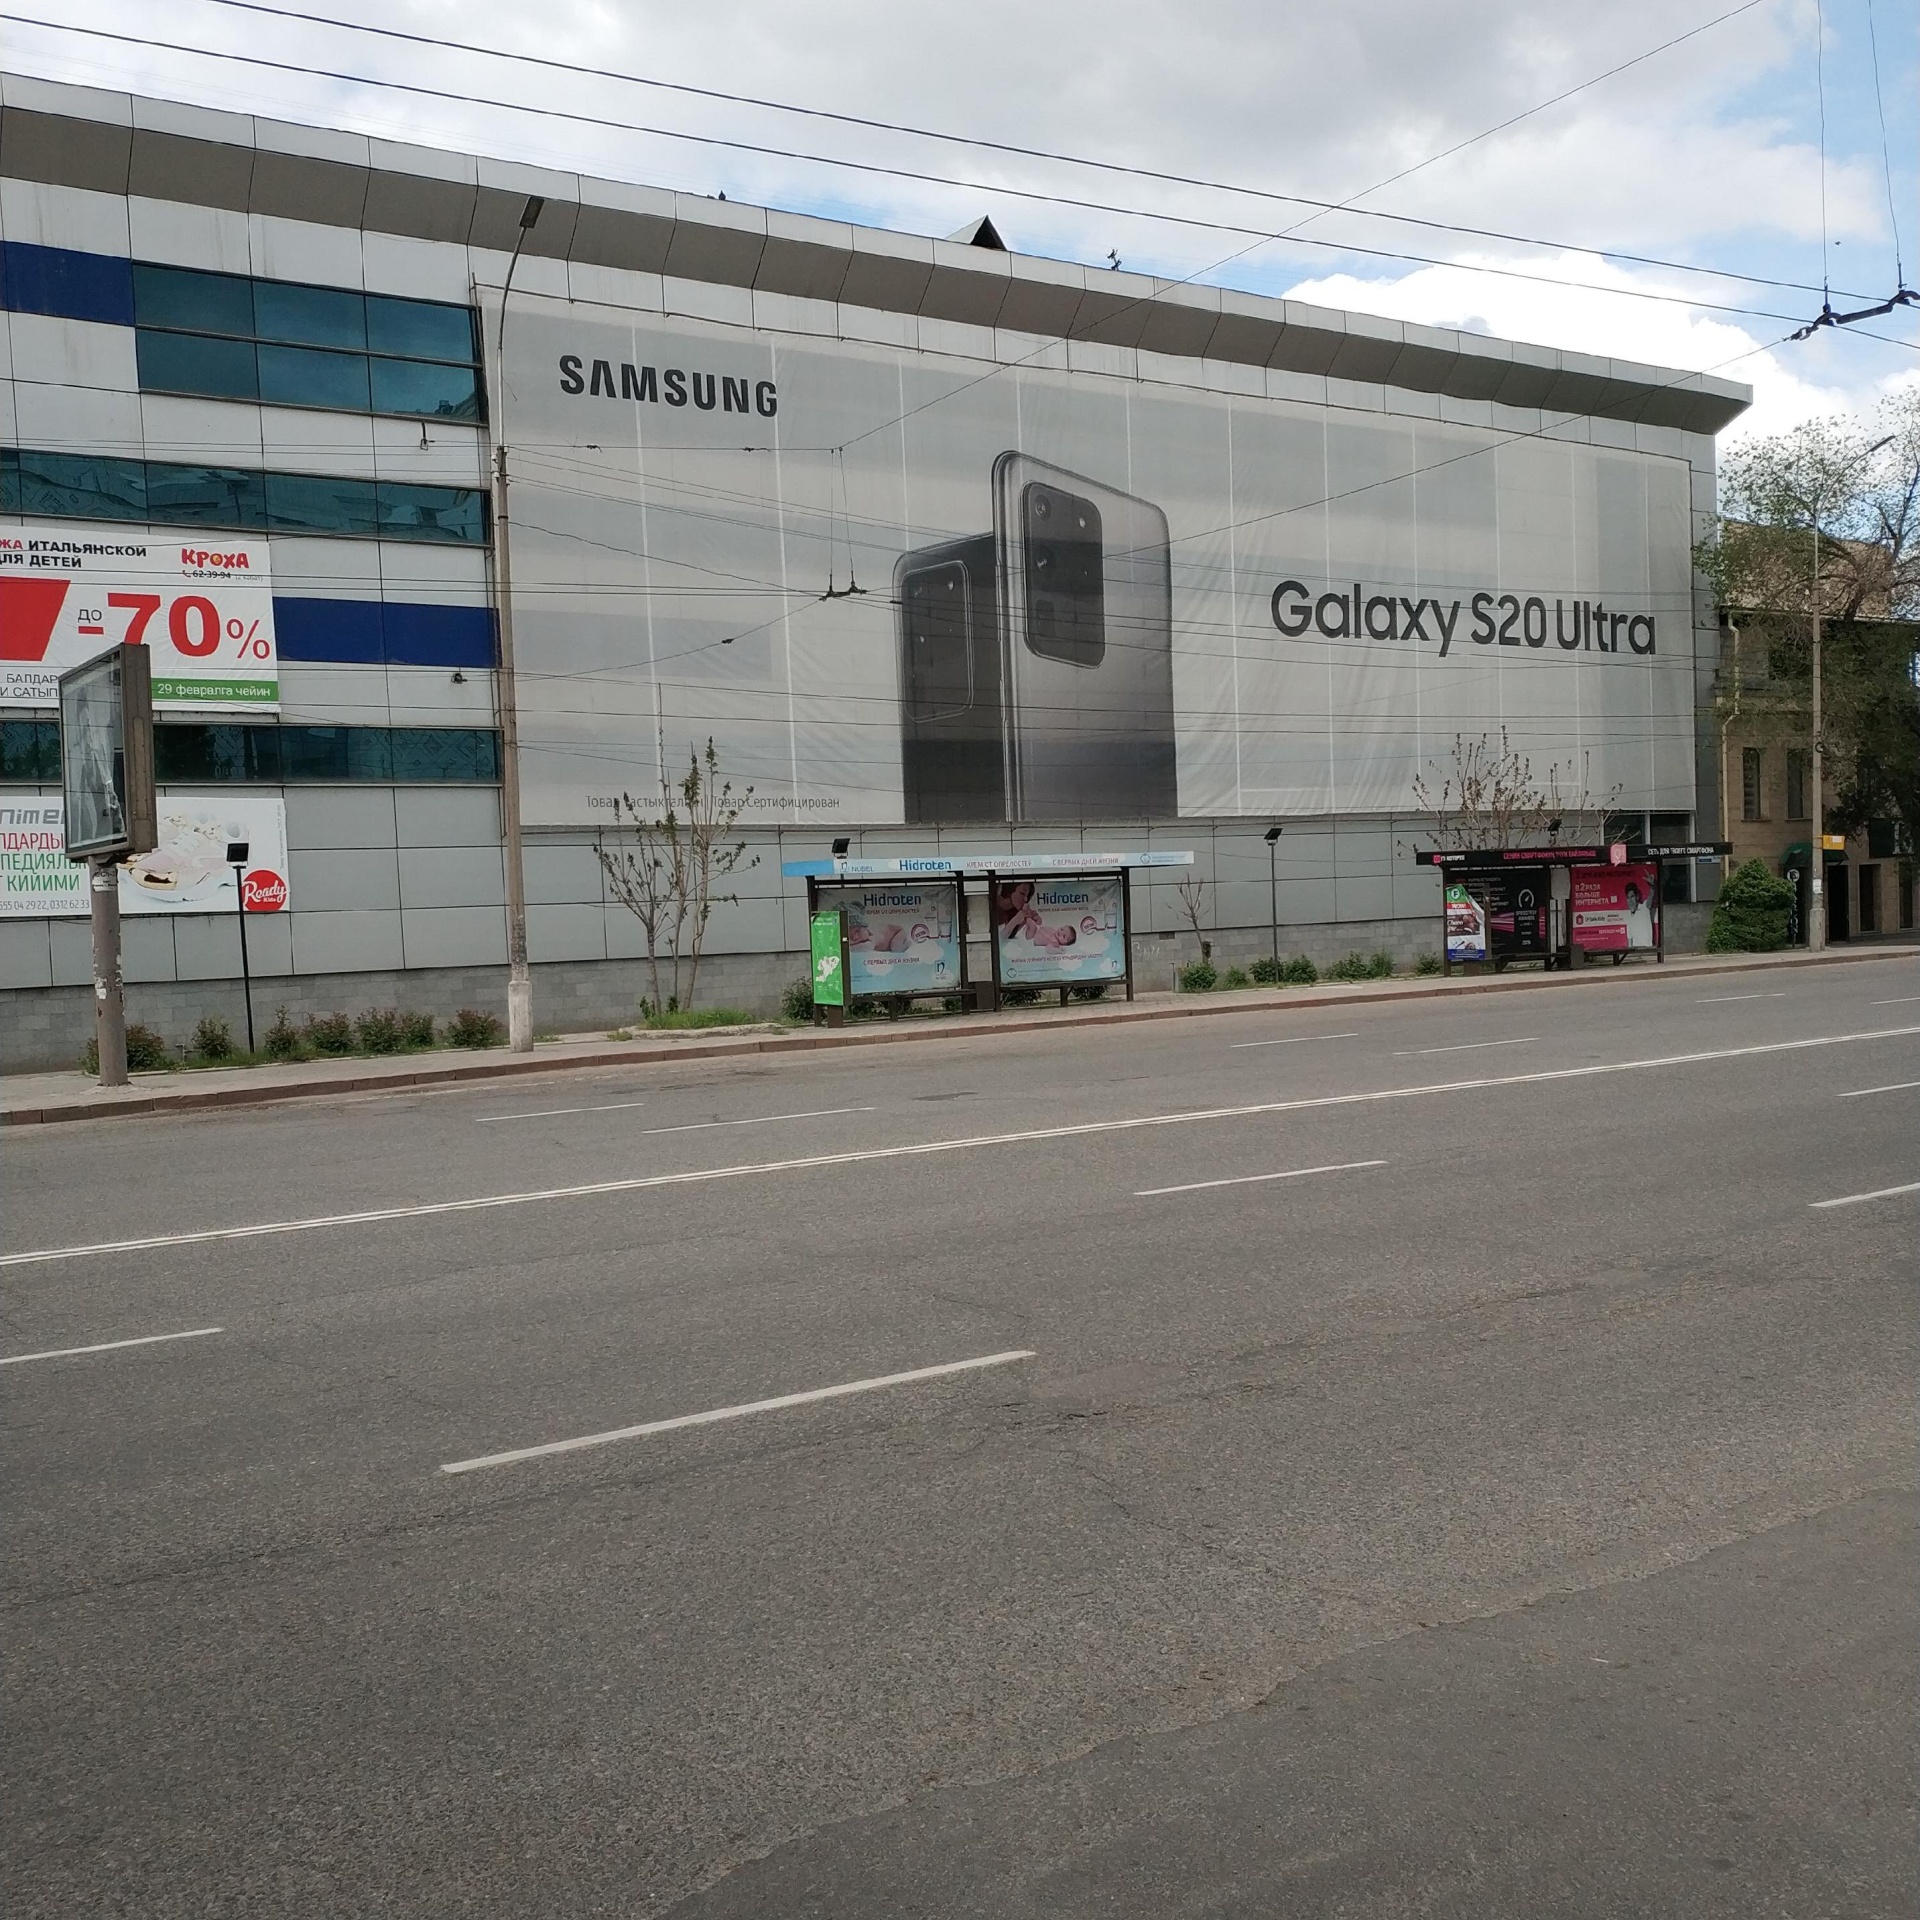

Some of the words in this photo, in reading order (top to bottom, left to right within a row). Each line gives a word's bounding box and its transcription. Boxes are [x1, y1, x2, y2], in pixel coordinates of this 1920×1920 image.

[559, 355, 778, 418] SAMSUNG
[28, 540, 147, 557] ИТАЛЬЯНСКОЙ
[29, 554, 82, 568] ДЕТЕЙ
[181, 548, 250, 569] КРОХА
[192, 569, 231, 580] 62-39-94
[77, 609, 102, 624] ДО
[1271, 579, 1461, 657] Galaxy
[1470, 592, 1547, 649] S20
[1556, 598, 1657, 655] Ultra
[157, 683, 172, 694] 29
[175, 682, 233, 698] февралга
[235, 686, 271, 697] чейин
[746, 795, 840, 811] Сертифицирован
[899, 859, 953, 871] Hidroten
[242, 879, 287, 904] Ready
[1036, 891, 1089, 905] Hidroten
[26, 900, 36, 911] 29
[864, 893, 921, 906] Hidroten
